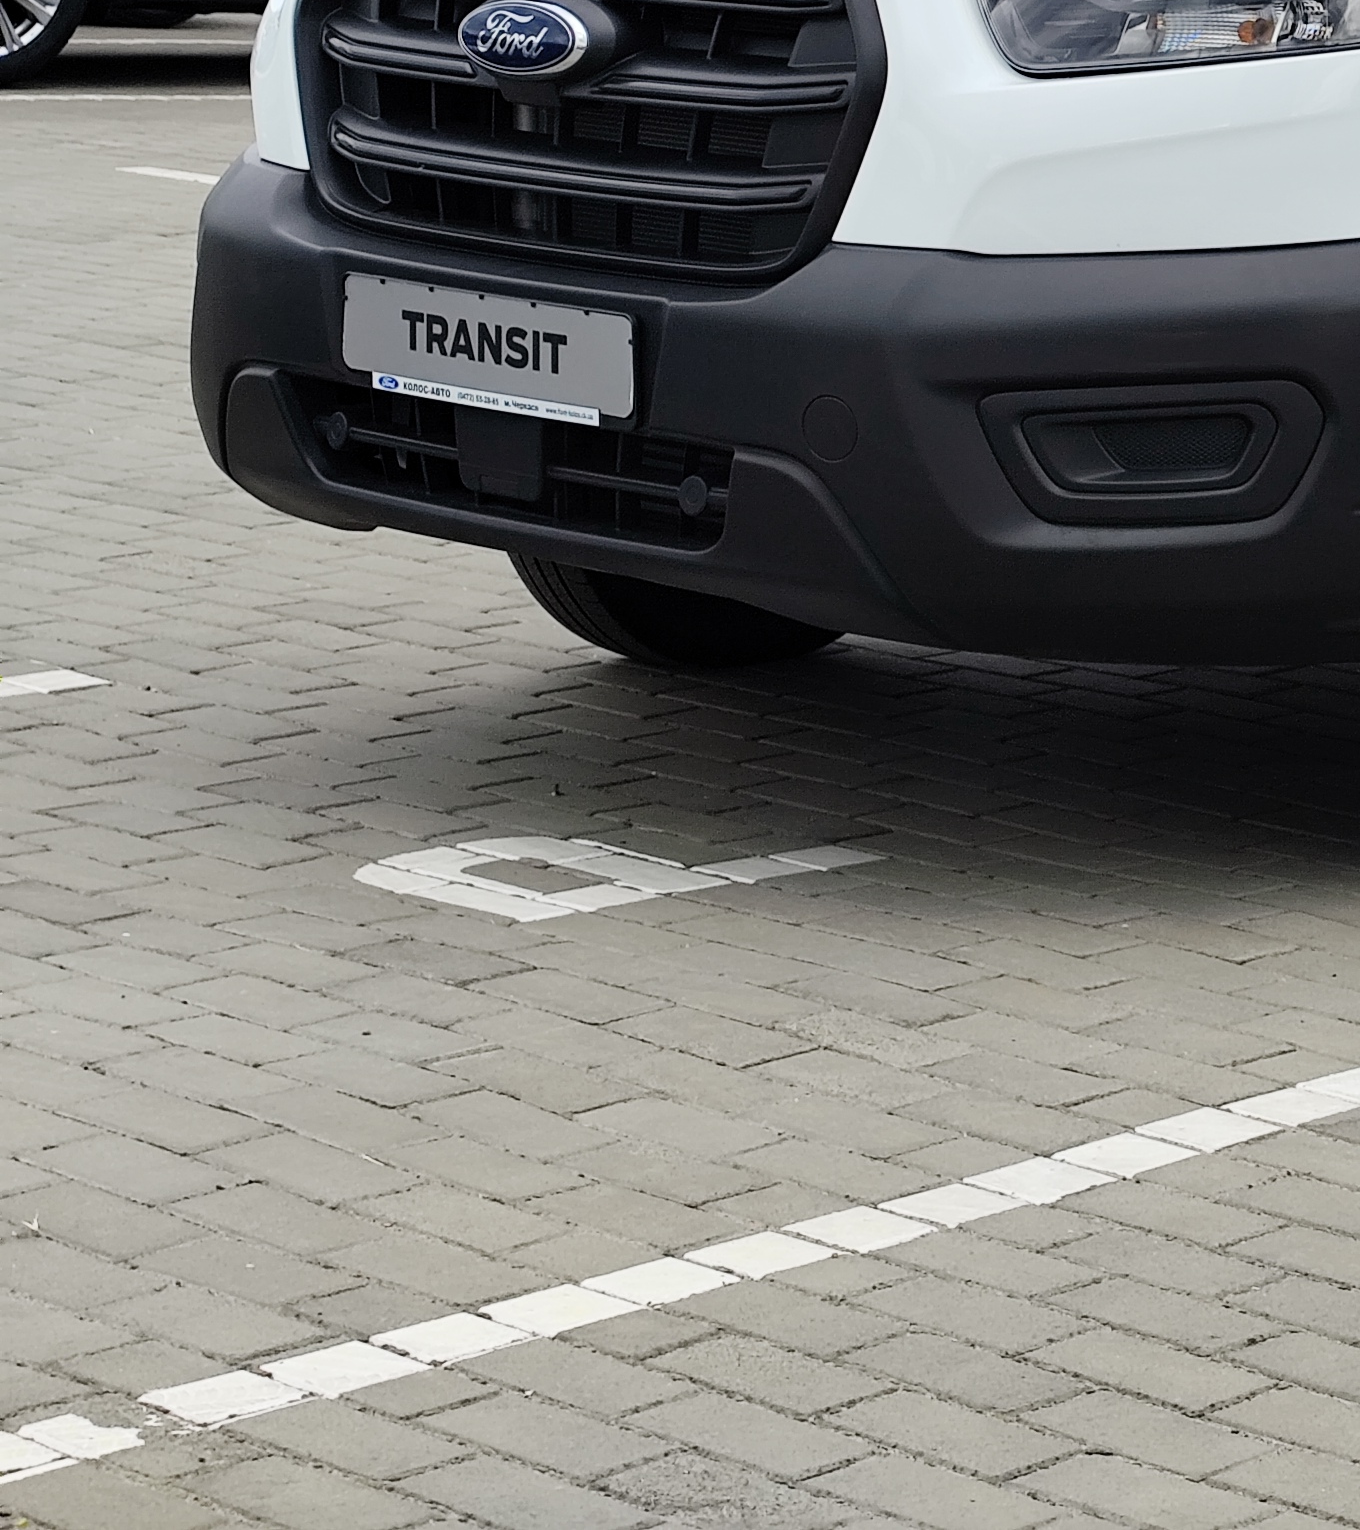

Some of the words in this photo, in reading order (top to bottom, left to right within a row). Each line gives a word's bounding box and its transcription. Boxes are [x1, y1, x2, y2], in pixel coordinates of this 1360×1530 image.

[477, 10, 549, 59] Ford
[401, 309, 567, 375] TRANSIT
[403, 381, 451, 398] КОЛОС-АВТО
